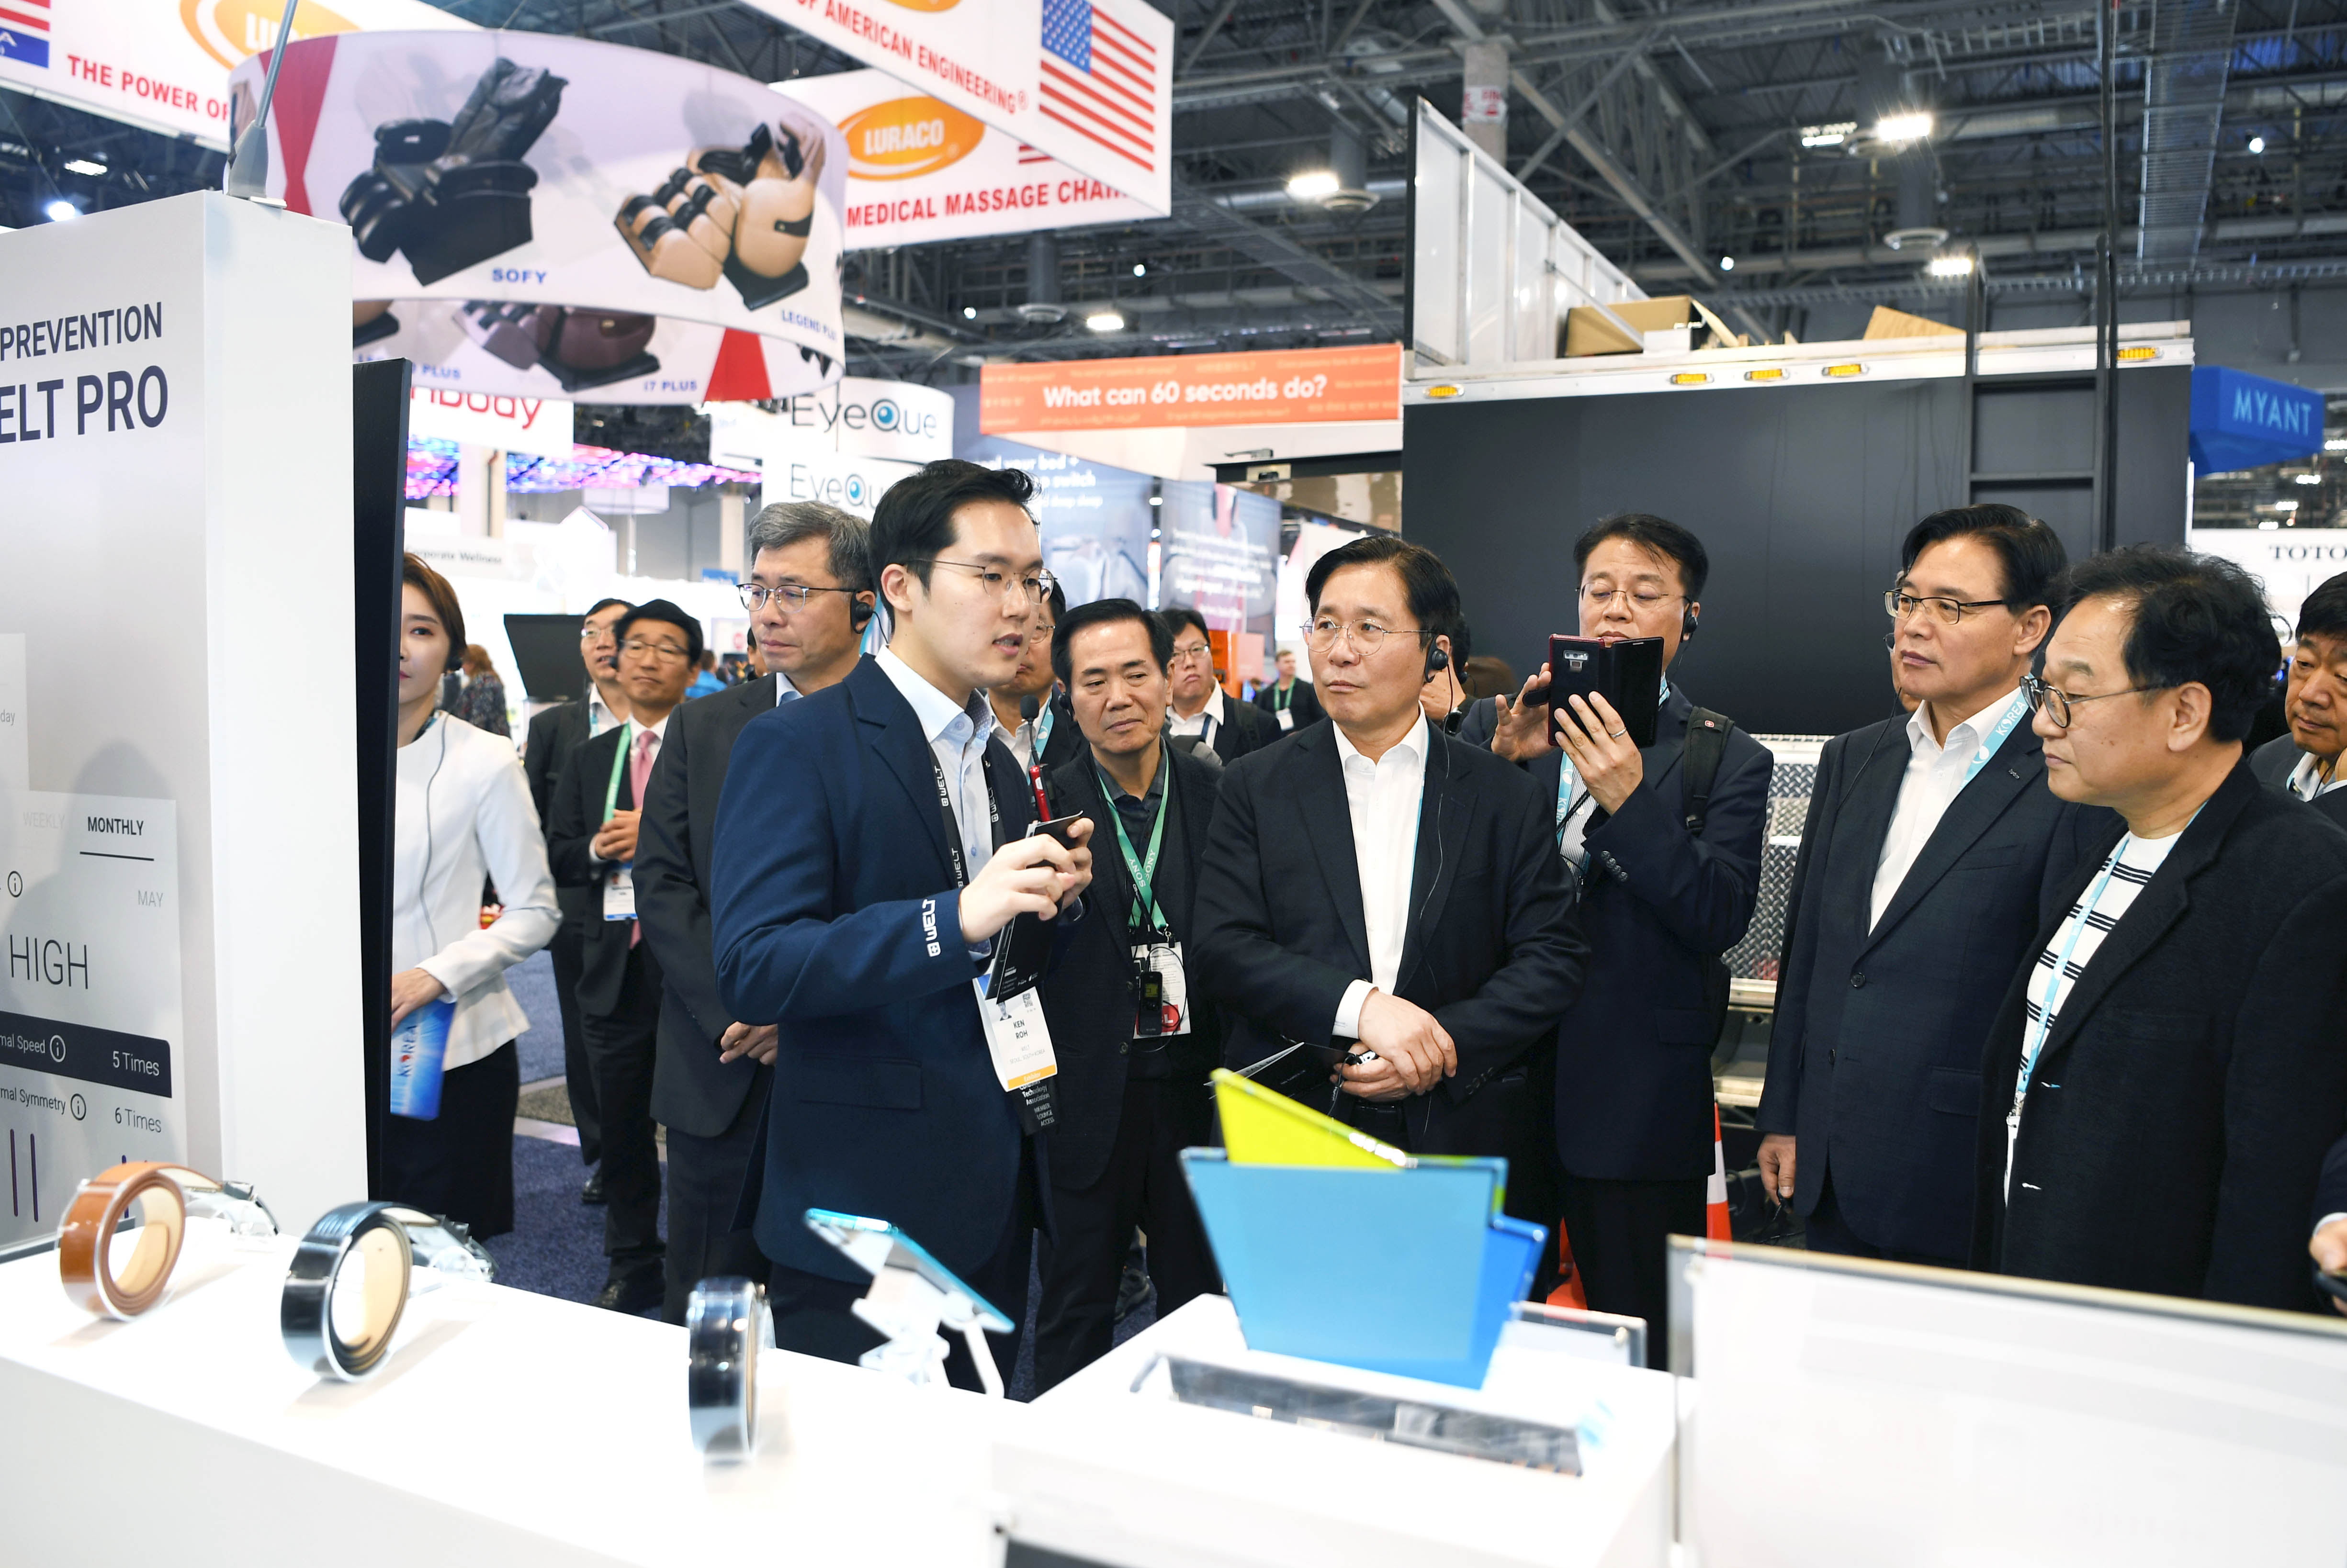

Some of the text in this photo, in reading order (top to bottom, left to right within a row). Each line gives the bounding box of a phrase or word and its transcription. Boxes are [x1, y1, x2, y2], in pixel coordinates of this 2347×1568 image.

[825, 0, 913, 61] AMERICAN
[68, 55, 113, 87] THE
[122, 71, 197, 112] POWER
[864, 118, 944, 156] LURACO
[847, 198, 937, 227] MEDICAL
[945, 184, 1049, 216] MASSAGE
[492, 268, 547, 284] SOFY
[0, 302, 162, 361] PREVENTION
[782, 309, 820, 333] LEGEND
[77, 365, 168, 435] PRO
[662, 381, 697, 392] PLUS
[1043, 385, 1101, 408] What
[1106, 387, 1147, 405] can
[1151, 381, 1180, 404] 60
[1185, 377, 1277, 403] seconds
[1283, 374, 1328, 398] do?
[792, 393, 937, 439] EyeQue
[2233, 387, 2312, 436] MYANT
[790, 463, 885, 510] EyeQu
[458, 551, 501, 564] Wellness
[2269, 544, 2347, 560] TOTO
[0, 709, 15, 726] day
[1996, 701, 2026, 736] KOREA
[934, 765, 949, 796] WELT
[988, 786, 998, 811] WELT
[23, 812, 144, 836] WEEKLY MONTHLY
[951, 847, 963, 879] WELT
[1128, 857, 1146, 887] SONY
[138, 890, 164, 908] MAY
[922, 899, 938, 941] WELT
[10, 934, 88, 989] HIGH
[1013, 1019, 1025, 1029] KEN
[1016, 1030, 1028, 1039] ROH
[17, 1035, 45, 1053] Speed
[113, 1051, 159, 1076] 5 Times
[0, 1087, 66, 1115] mal Symmetry
[1022, 1085, 1048, 1098] Technology
[115, 1107, 161, 1133] 6 Times
